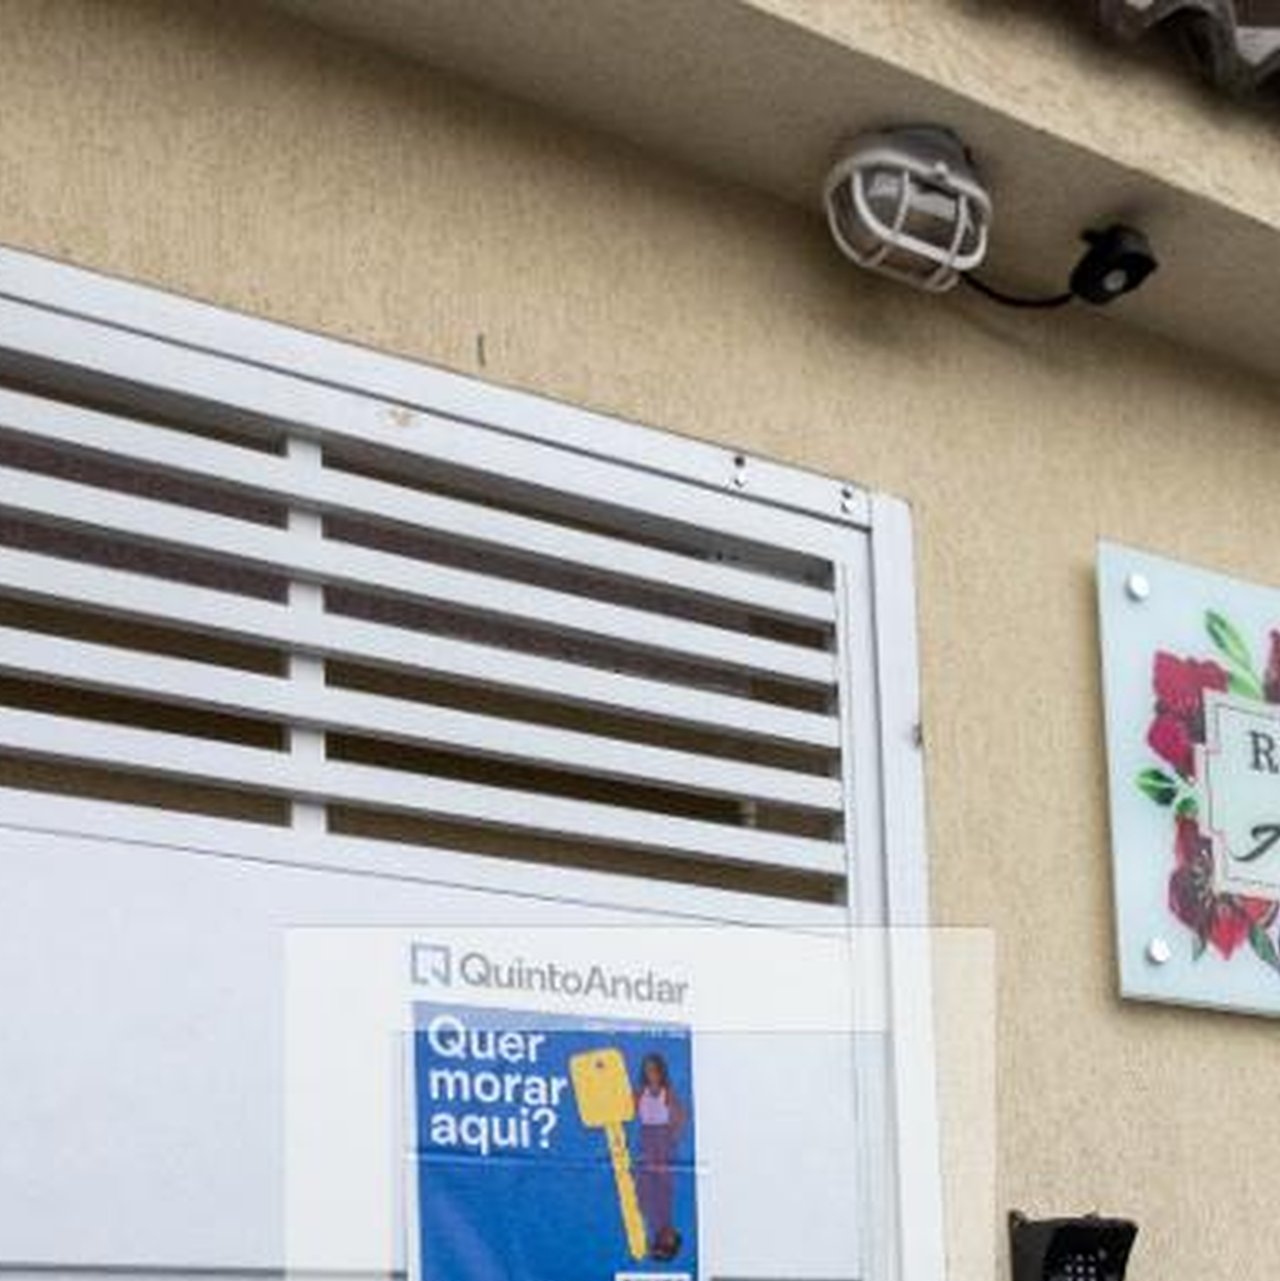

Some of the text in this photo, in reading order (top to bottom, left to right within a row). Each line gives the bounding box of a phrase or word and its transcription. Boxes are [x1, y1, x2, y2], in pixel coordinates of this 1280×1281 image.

[460, 952, 689, 1005] QuintoAndar
[427, 1014, 545, 1062] Quer
[429, 1066, 568, 1106] morar
[430, 1107, 558, 1155] aqui?
